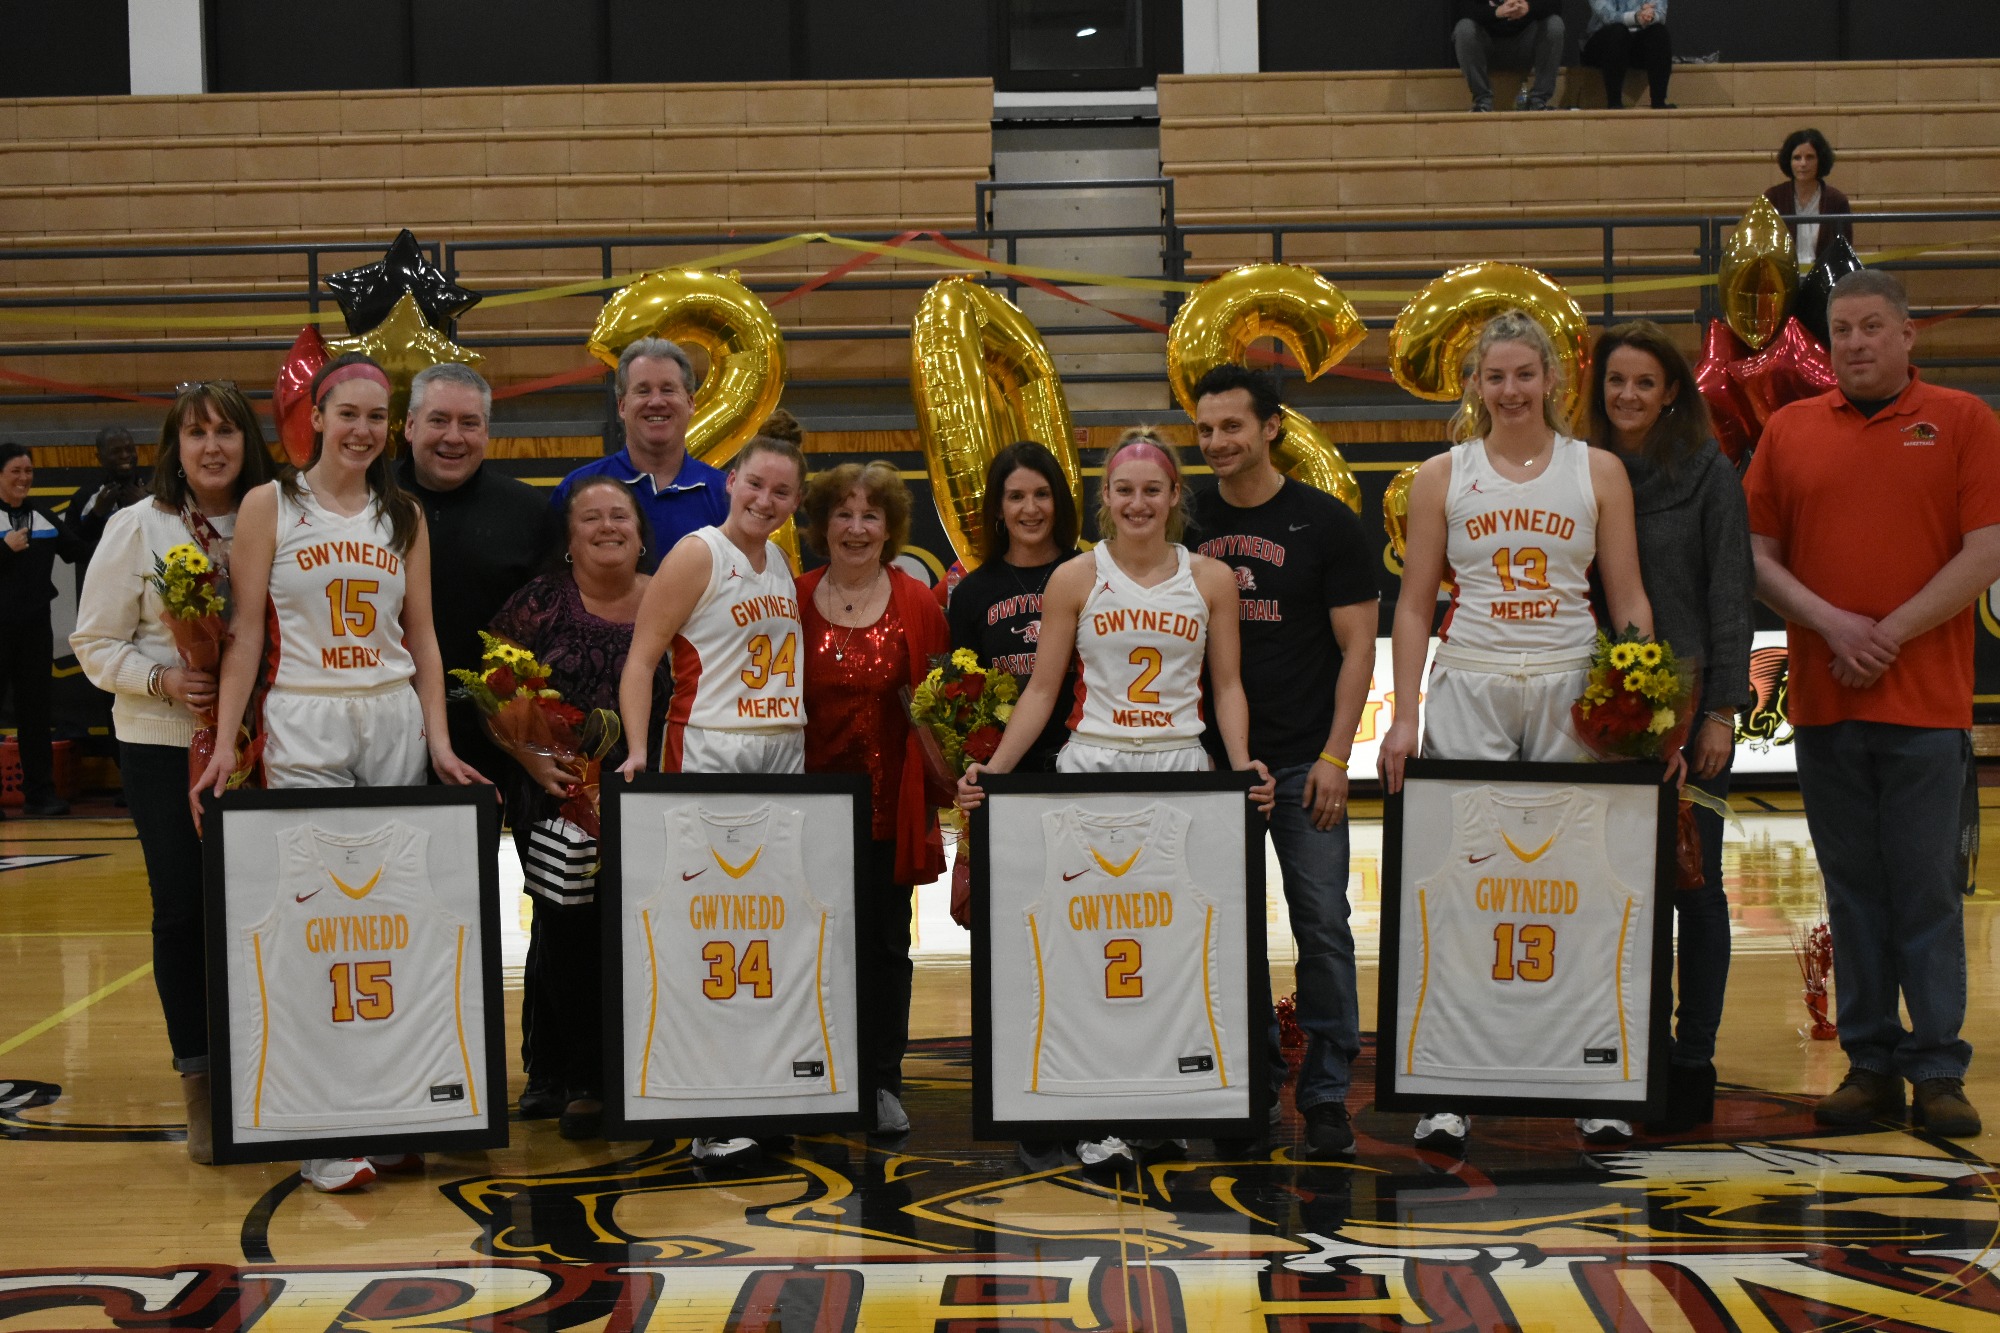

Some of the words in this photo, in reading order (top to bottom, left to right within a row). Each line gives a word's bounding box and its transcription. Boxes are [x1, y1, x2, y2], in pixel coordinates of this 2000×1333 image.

[1465, 508, 1576, 541] GWYNEDD
[296, 541, 399, 576] GWYNEDD
[1197, 534, 1285, 567] GWYNEDD
[1492, 547, 1550, 591] 13
[325, 578, 379, 637] 15
[1093, 608, 1199, 642] GWYNEDD
[1490, 598, 1560, 619] MERCY
[321, 645, 385, 669] MERCY
[740, 632, 797, 690] 34
[1127, 646, 1163, 704] 2
[737, 697, 800, 719] MERCY
[689, 894, 785, 930] GWYNEDD
[1068, 891, 1173, 931] GWYNEDD
[1475, 877, 1579, 915] GWYNEDD
[305, 914, 409, 953] GWYNEDD
[1492, 923, 1556, 982] 13
[702, 940, 773, 1000] 34
[1104, 938, 1143, 999] 2
[329, 960, 395, 1022] 15
